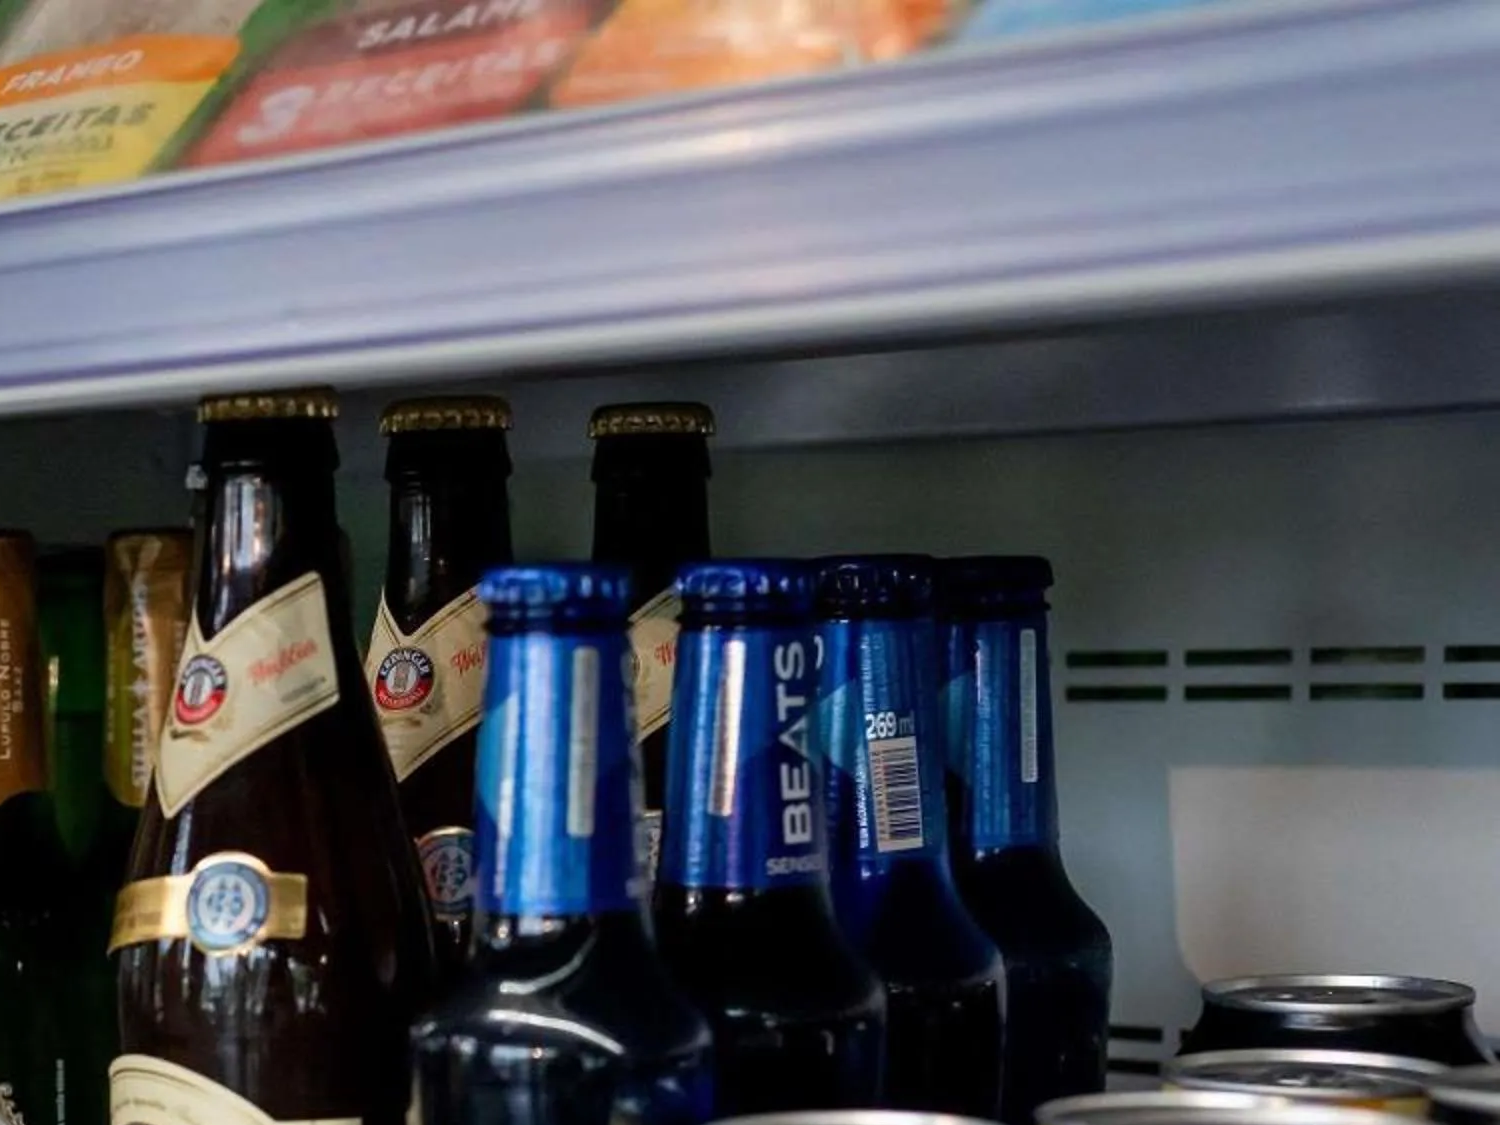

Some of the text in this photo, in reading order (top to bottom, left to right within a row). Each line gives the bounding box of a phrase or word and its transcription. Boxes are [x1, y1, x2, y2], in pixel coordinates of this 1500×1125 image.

[358, 0, 540, 48] SALAM
[774, 641, 812, 845] BEATS
[865, 711, 897, 740] 269
